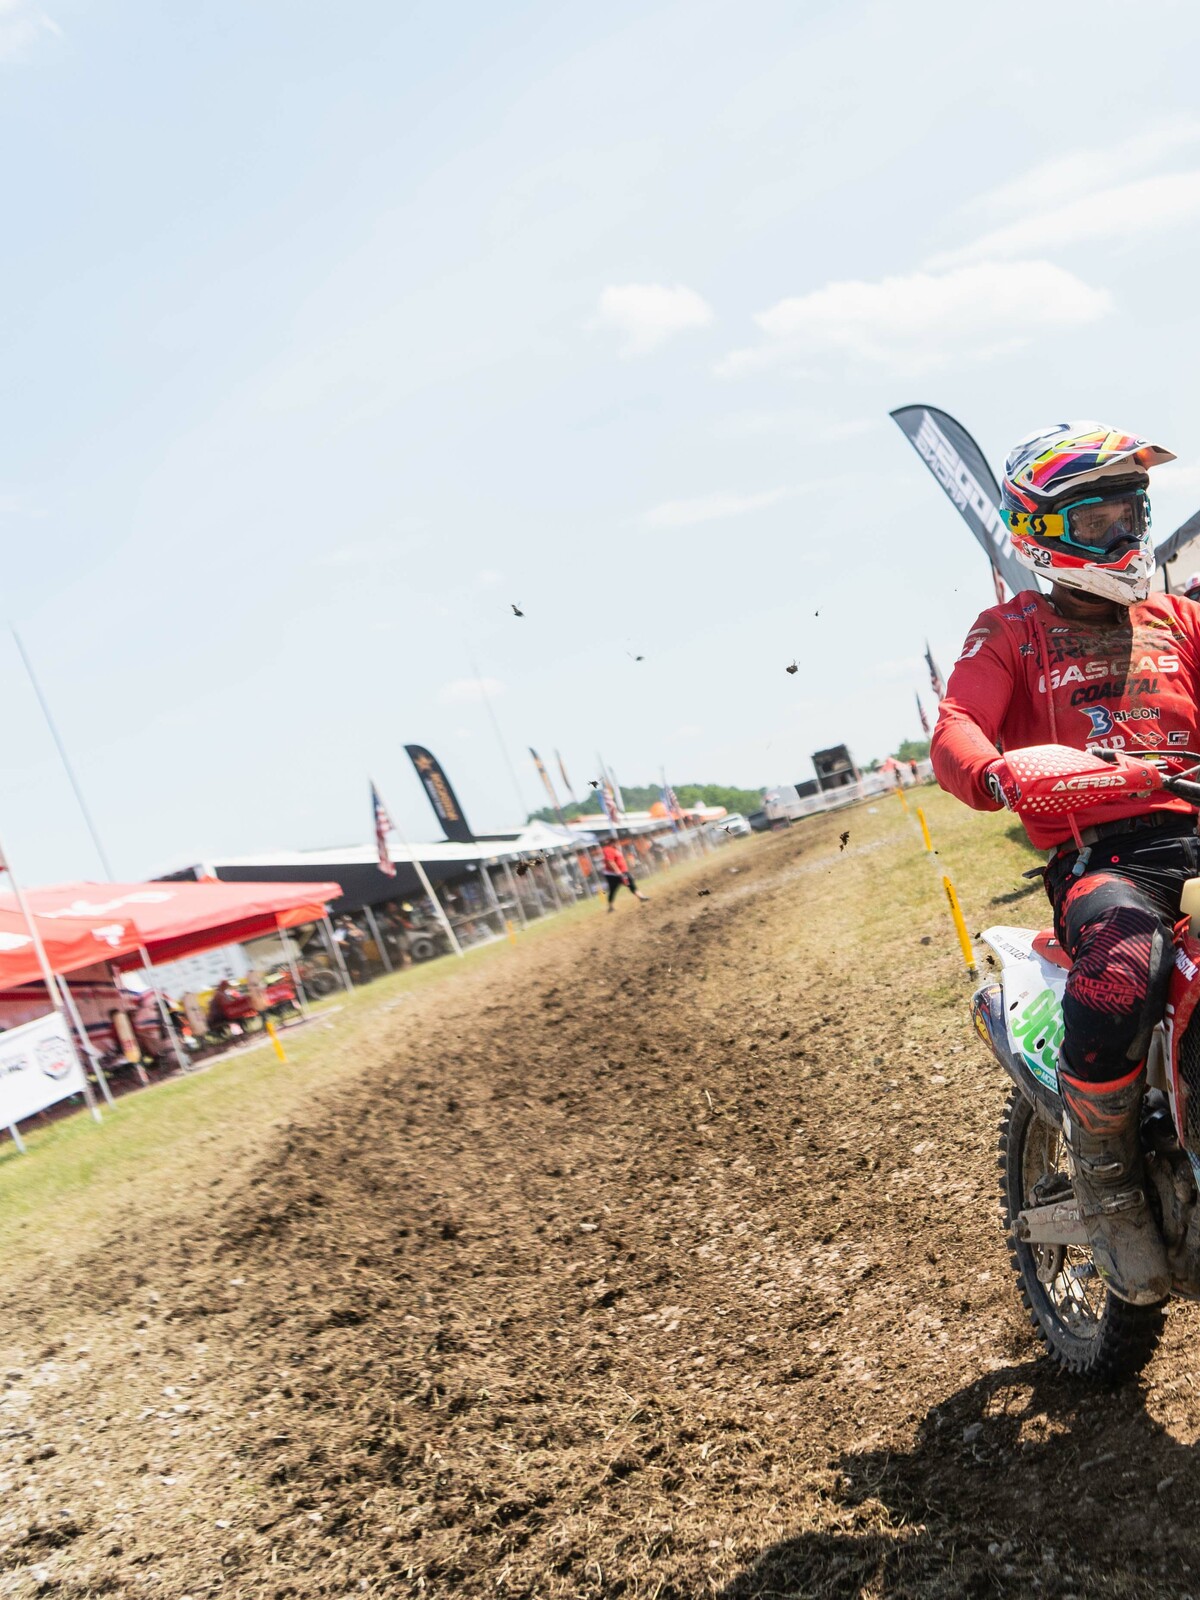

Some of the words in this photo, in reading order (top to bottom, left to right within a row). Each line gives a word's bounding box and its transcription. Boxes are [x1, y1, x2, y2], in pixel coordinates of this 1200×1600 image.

[1038, 655, 1179, 694] GASGAS
[1071, 679, 1161, 706] COASTAL
[1051, 776, 1127, 792] ACERBIS
[1074, 984, 1135, 1005] RACING
[1075, 974, 1137, 994] MOOSE
